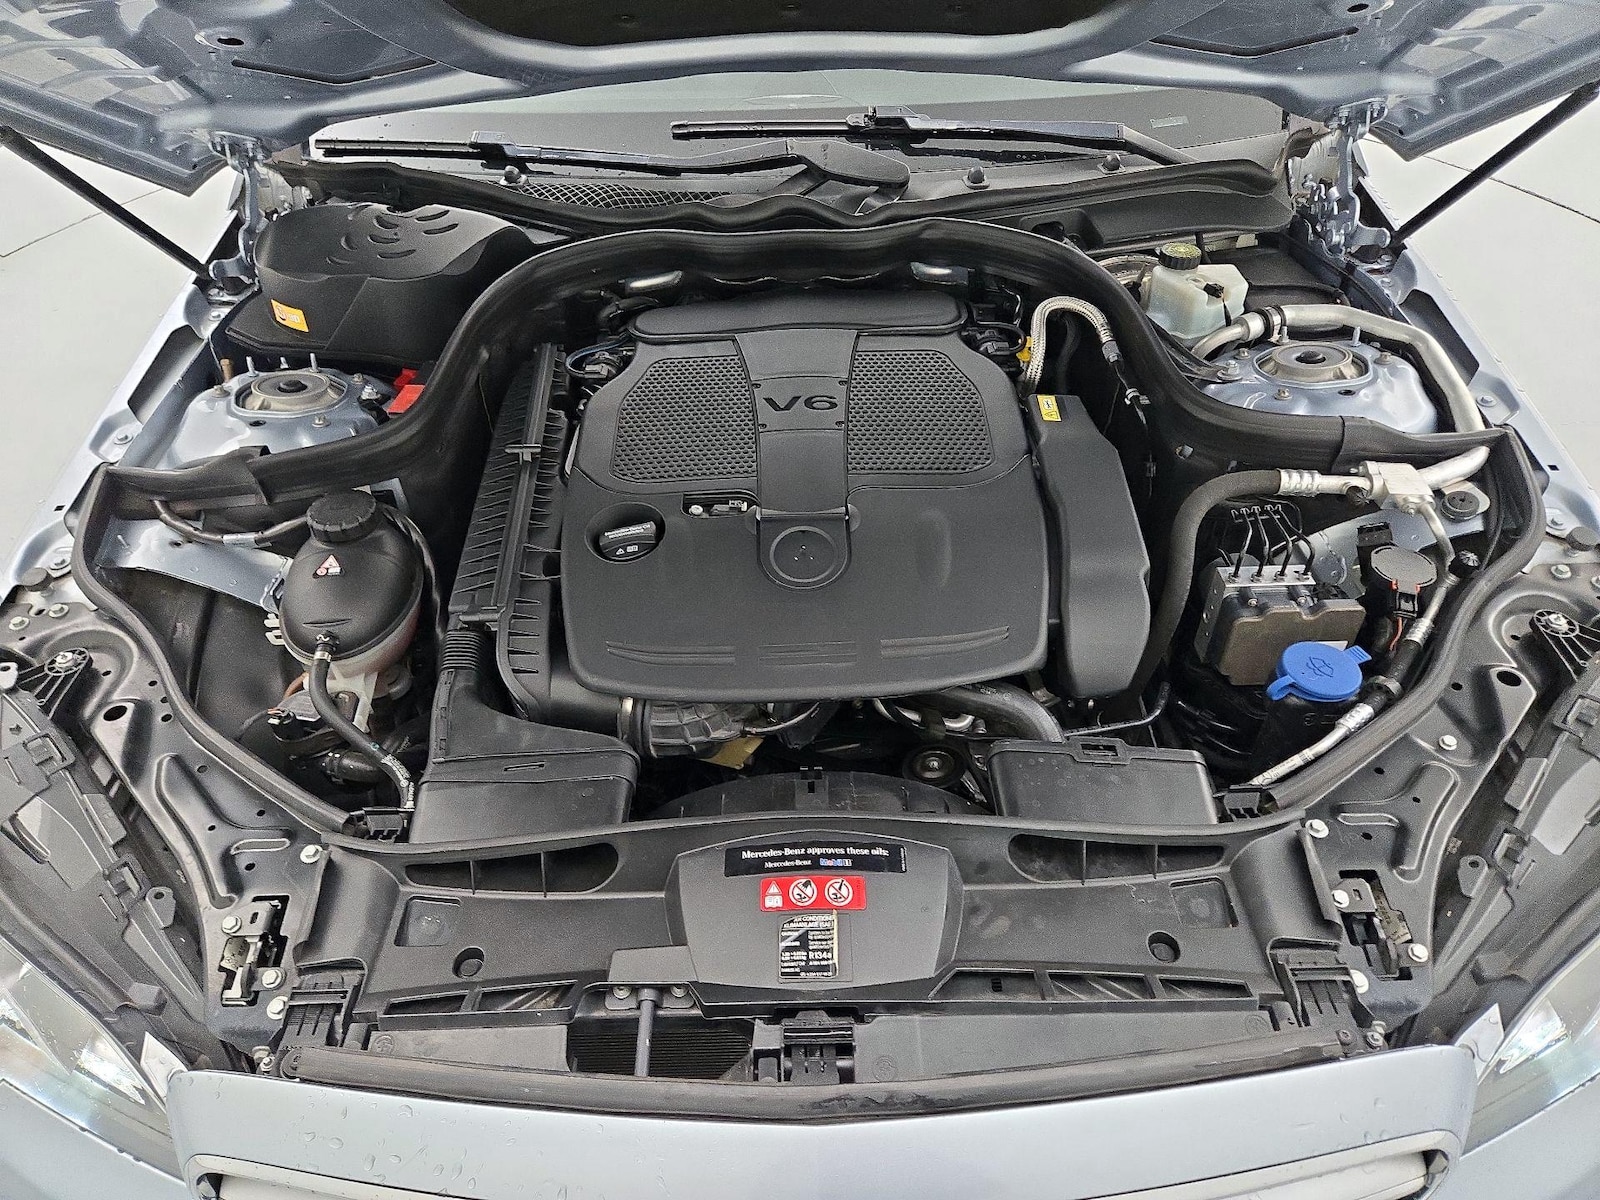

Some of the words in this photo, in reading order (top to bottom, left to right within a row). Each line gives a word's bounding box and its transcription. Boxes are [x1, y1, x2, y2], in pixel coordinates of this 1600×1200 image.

[762, 395, 838, 412] V6
[741, 847, 805, 859] Mercedes-Benz
[806, 846, 845, 855] approves
[846, 846, 870, 855] these
[764, 859, 812, 868] Mercedes-Benz
